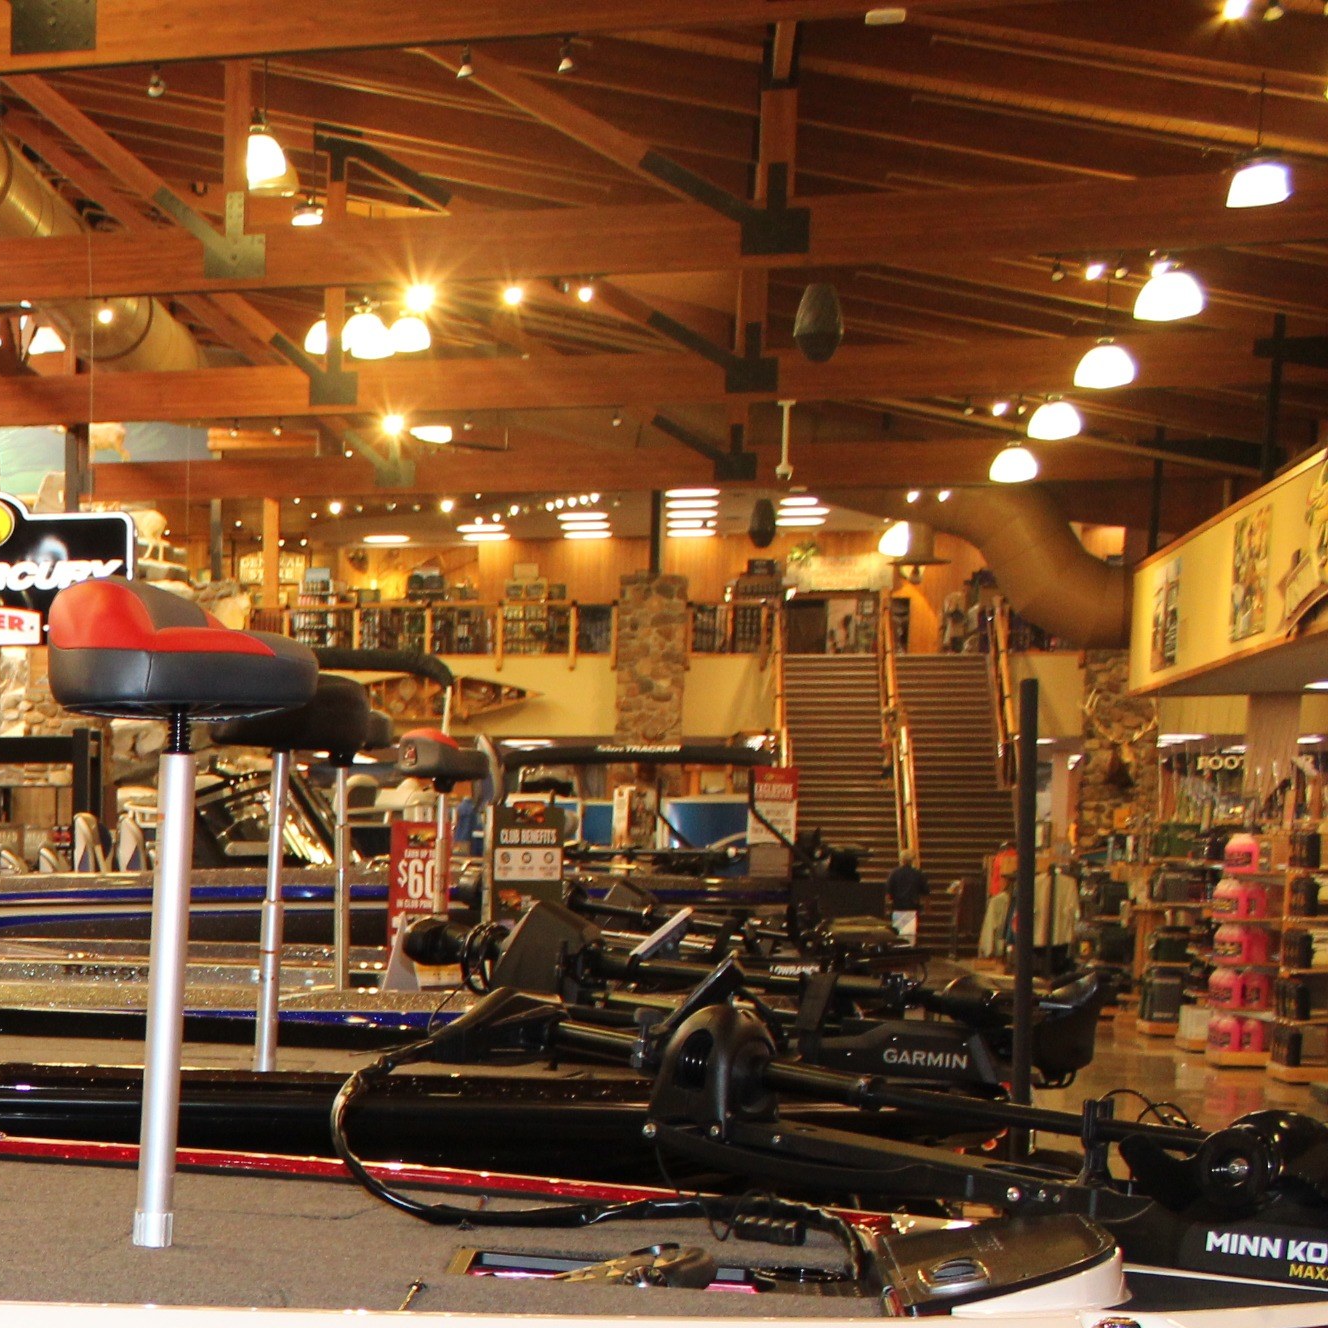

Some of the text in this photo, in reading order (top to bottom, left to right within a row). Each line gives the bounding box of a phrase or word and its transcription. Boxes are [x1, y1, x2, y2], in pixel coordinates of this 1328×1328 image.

[500, 829, 557, 845] CLUB BENEFITS
[61, 964, 150, 981] Range
[883, 1048, 969, 1070] GARMIN
[1205, 1231, 1282, 1259] MINN
